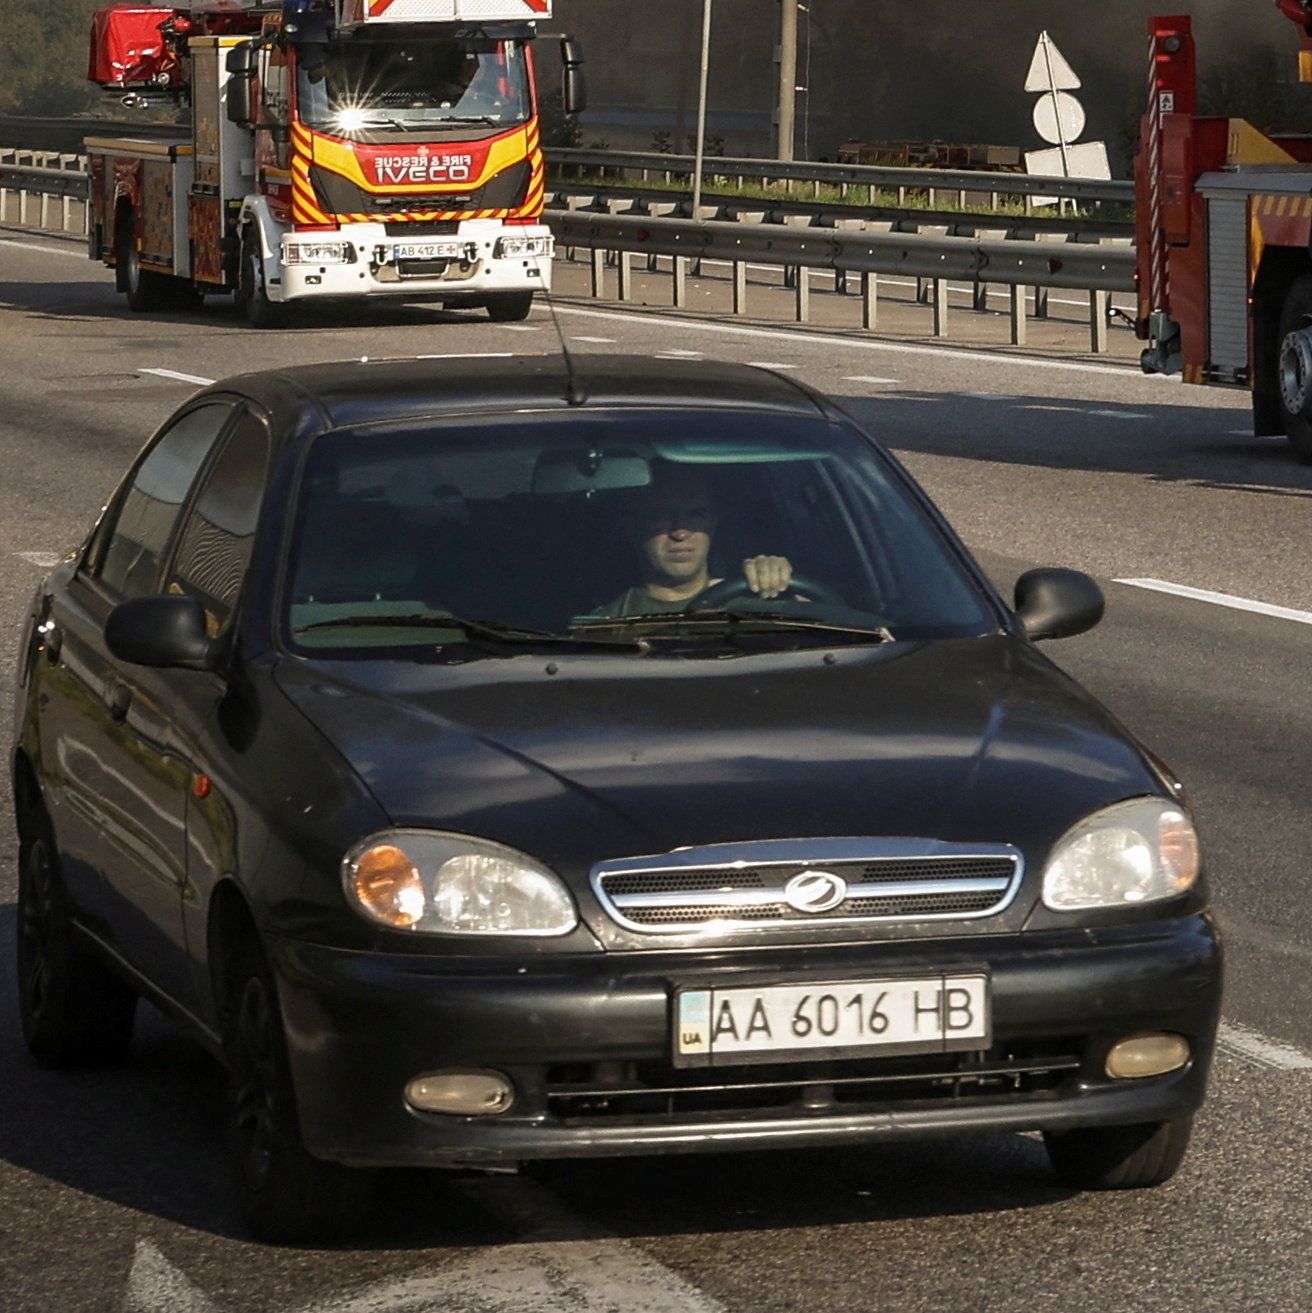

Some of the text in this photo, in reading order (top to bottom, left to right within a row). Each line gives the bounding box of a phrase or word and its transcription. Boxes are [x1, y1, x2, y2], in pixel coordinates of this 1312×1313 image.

[376, 165, 469, 184] IVECO
[417, 245, 435, 256] 412
[711, 997, 773, 1044] AA
[791, 990, 889, 1038] 6016
[682, 1032, 702, 1046] UA
